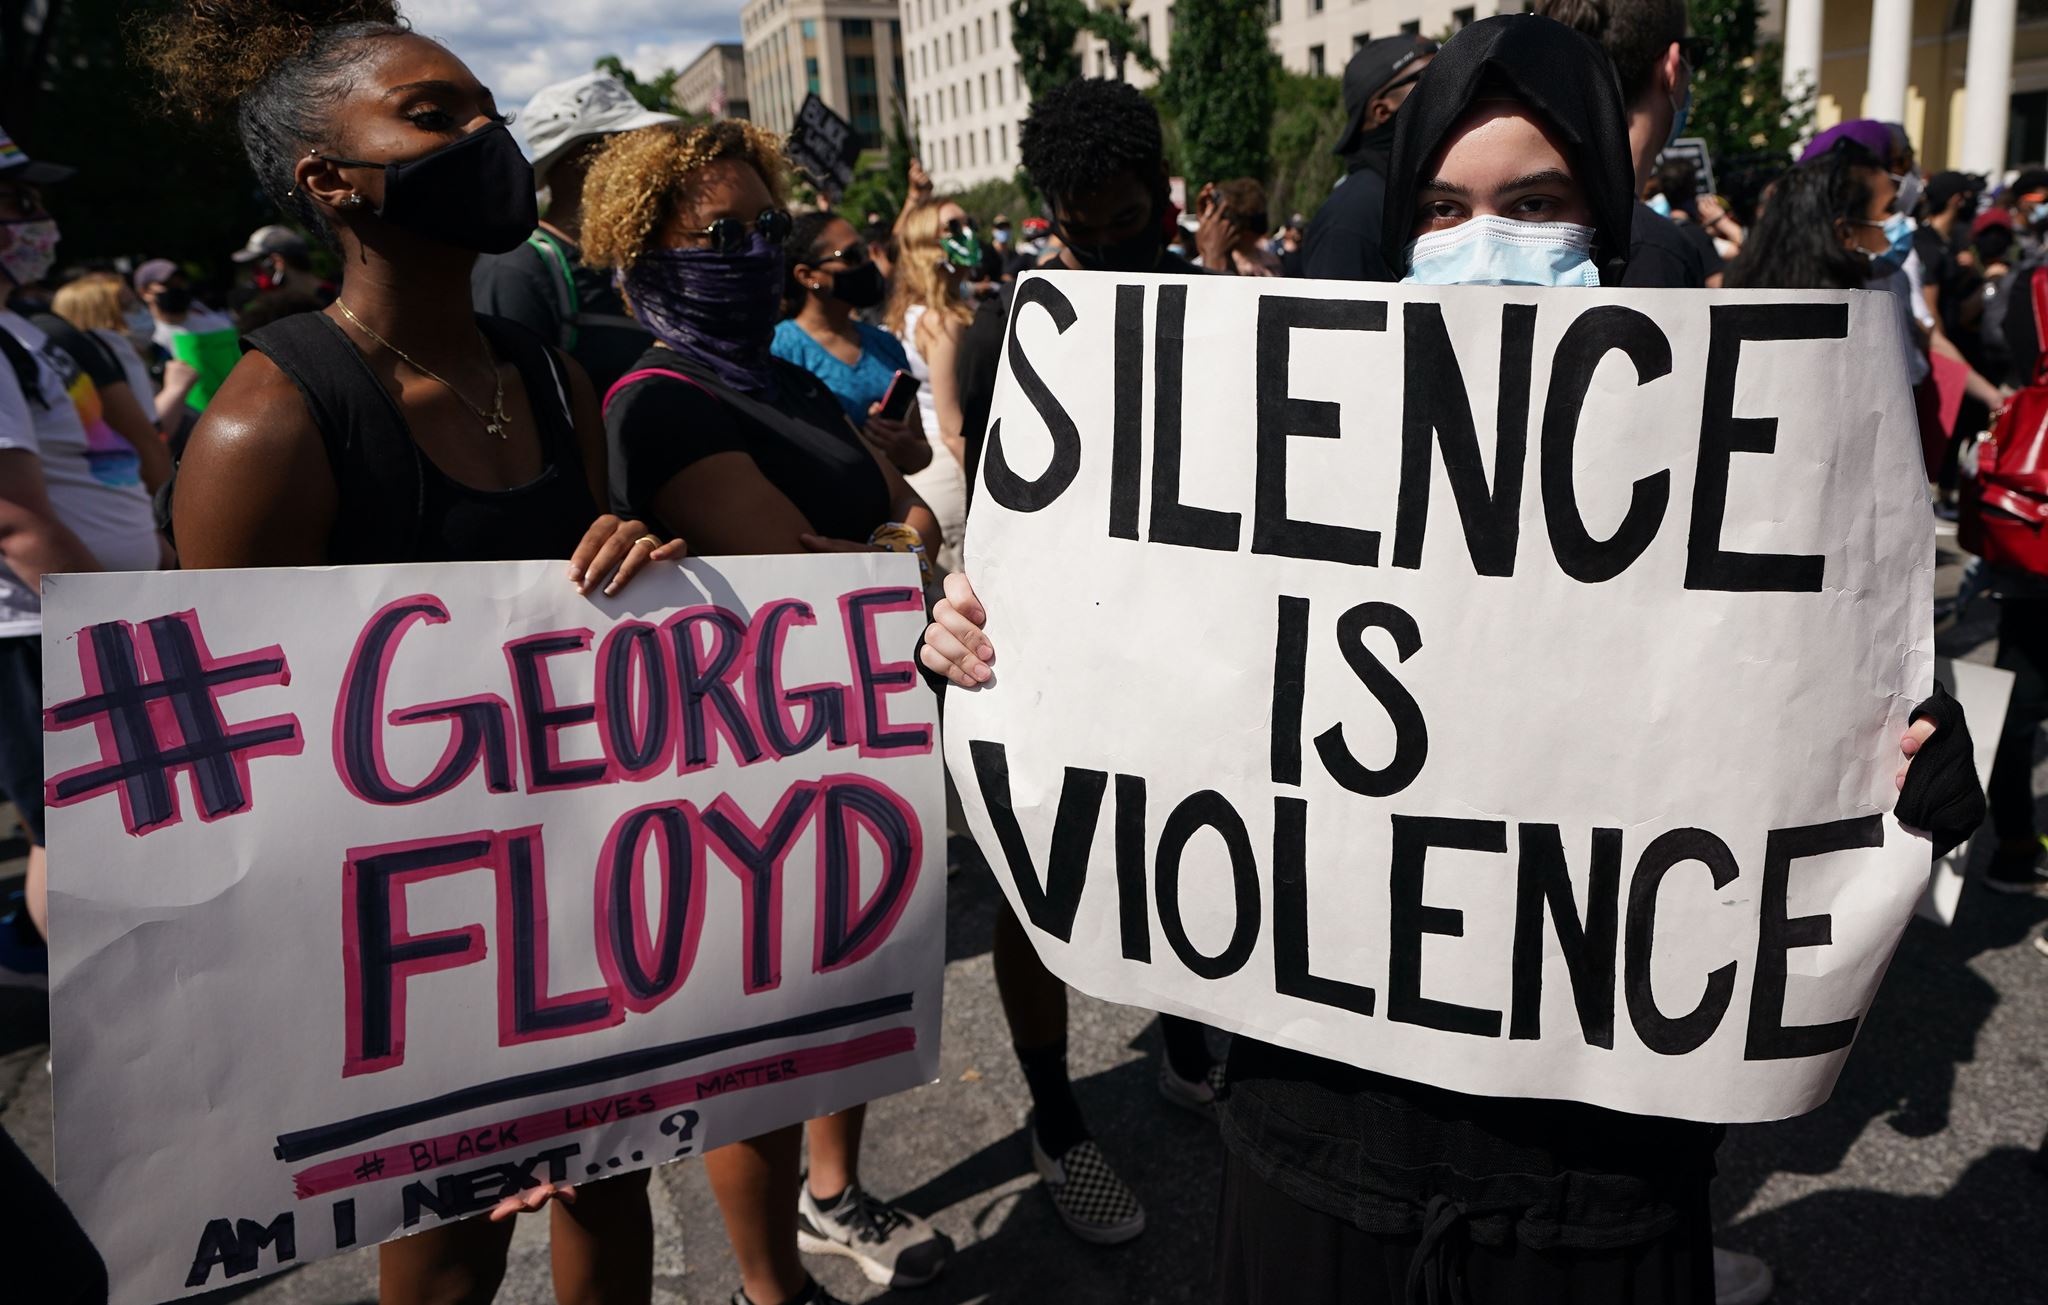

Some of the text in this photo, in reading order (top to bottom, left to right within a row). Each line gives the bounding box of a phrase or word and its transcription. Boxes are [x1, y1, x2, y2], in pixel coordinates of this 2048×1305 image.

[984, 277, 1848, 592] SILENCE
[1270, 595, 1428, 797] IS
[342, 773, 923, 1078] FLOYD
[969, 740, 1884, 1061] VIOLENCE
[565, 1094, 656, 1130] LIVES
[696, 1058, 798, 1100] MATTER
[185, 1211, 296, 1288] AM
[333, 1198, 356, 1249] I
